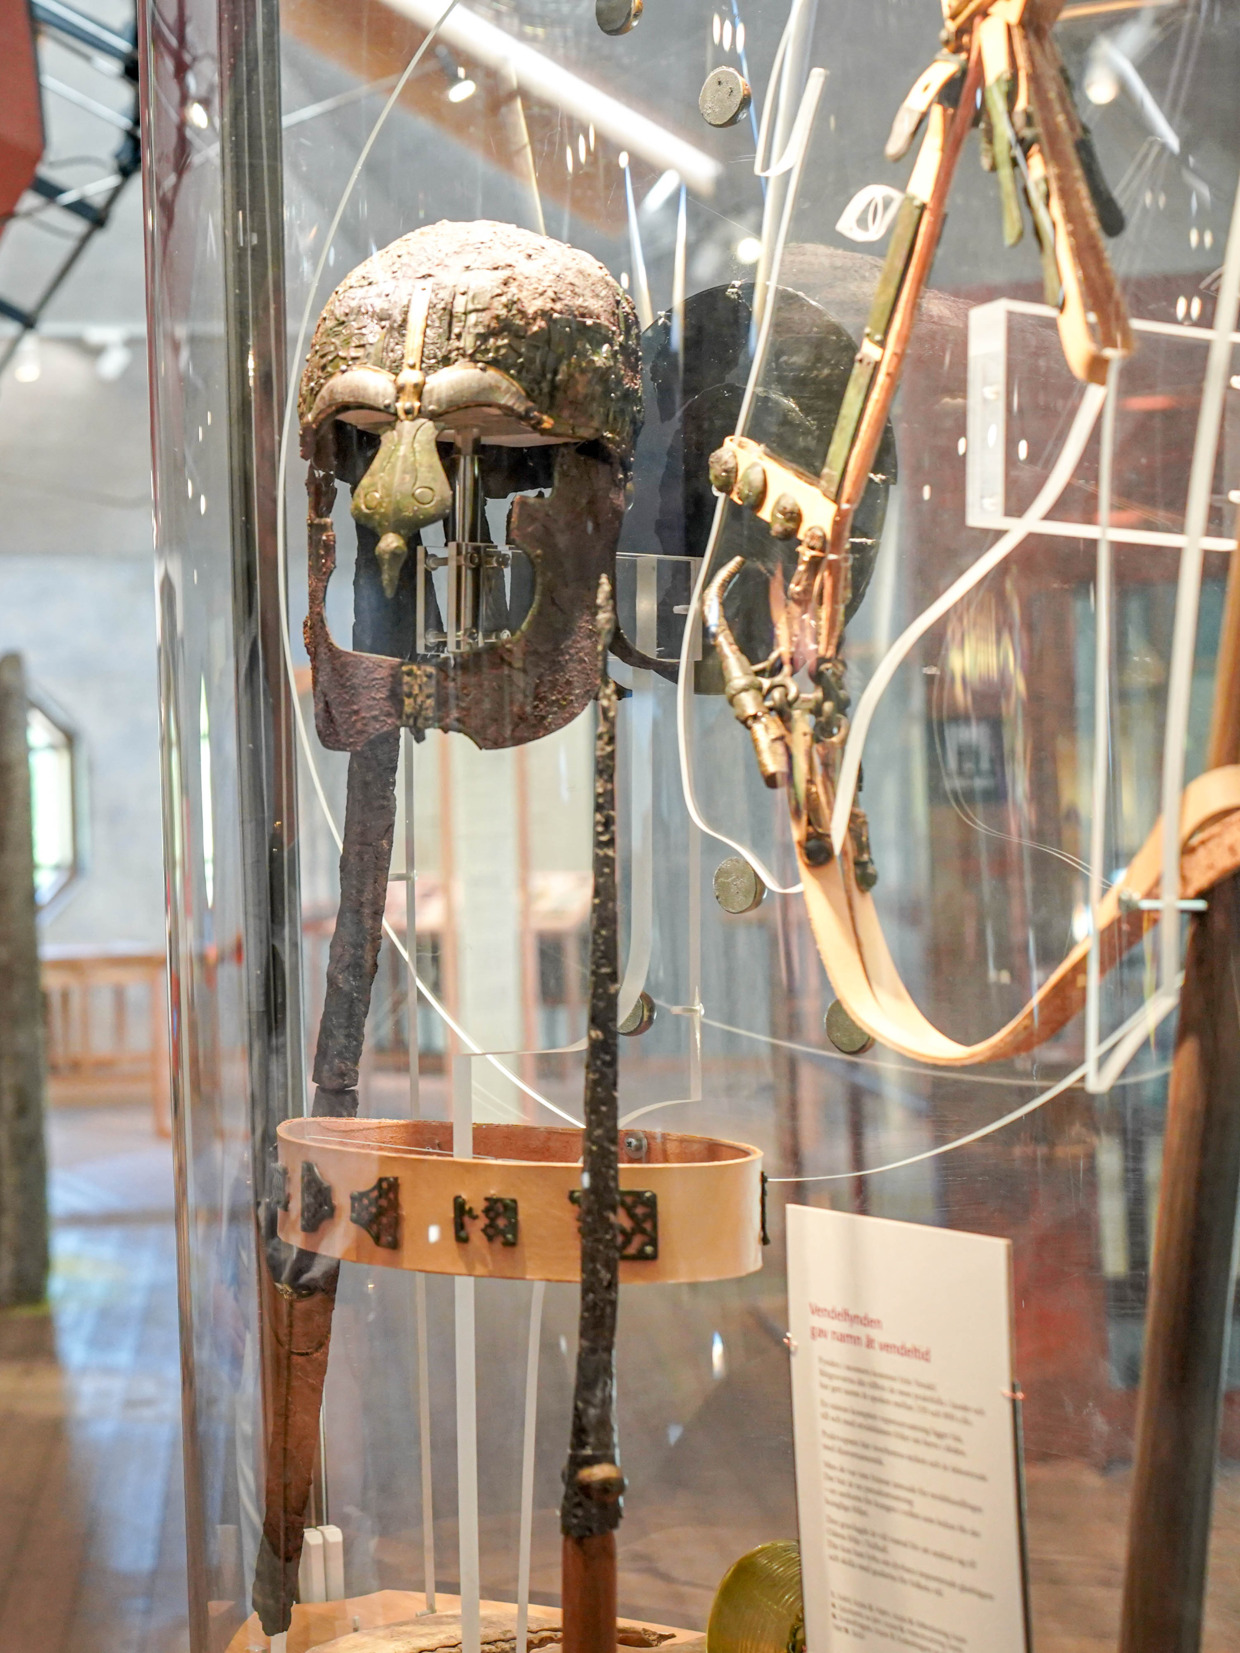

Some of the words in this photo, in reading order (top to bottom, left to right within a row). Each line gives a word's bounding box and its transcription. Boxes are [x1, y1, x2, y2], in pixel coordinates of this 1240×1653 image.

[810, 1326, 828, 1341] gav
[831, 1330, 863, 1347] namn
[878, 1341, 931, 1363] vendeltid
